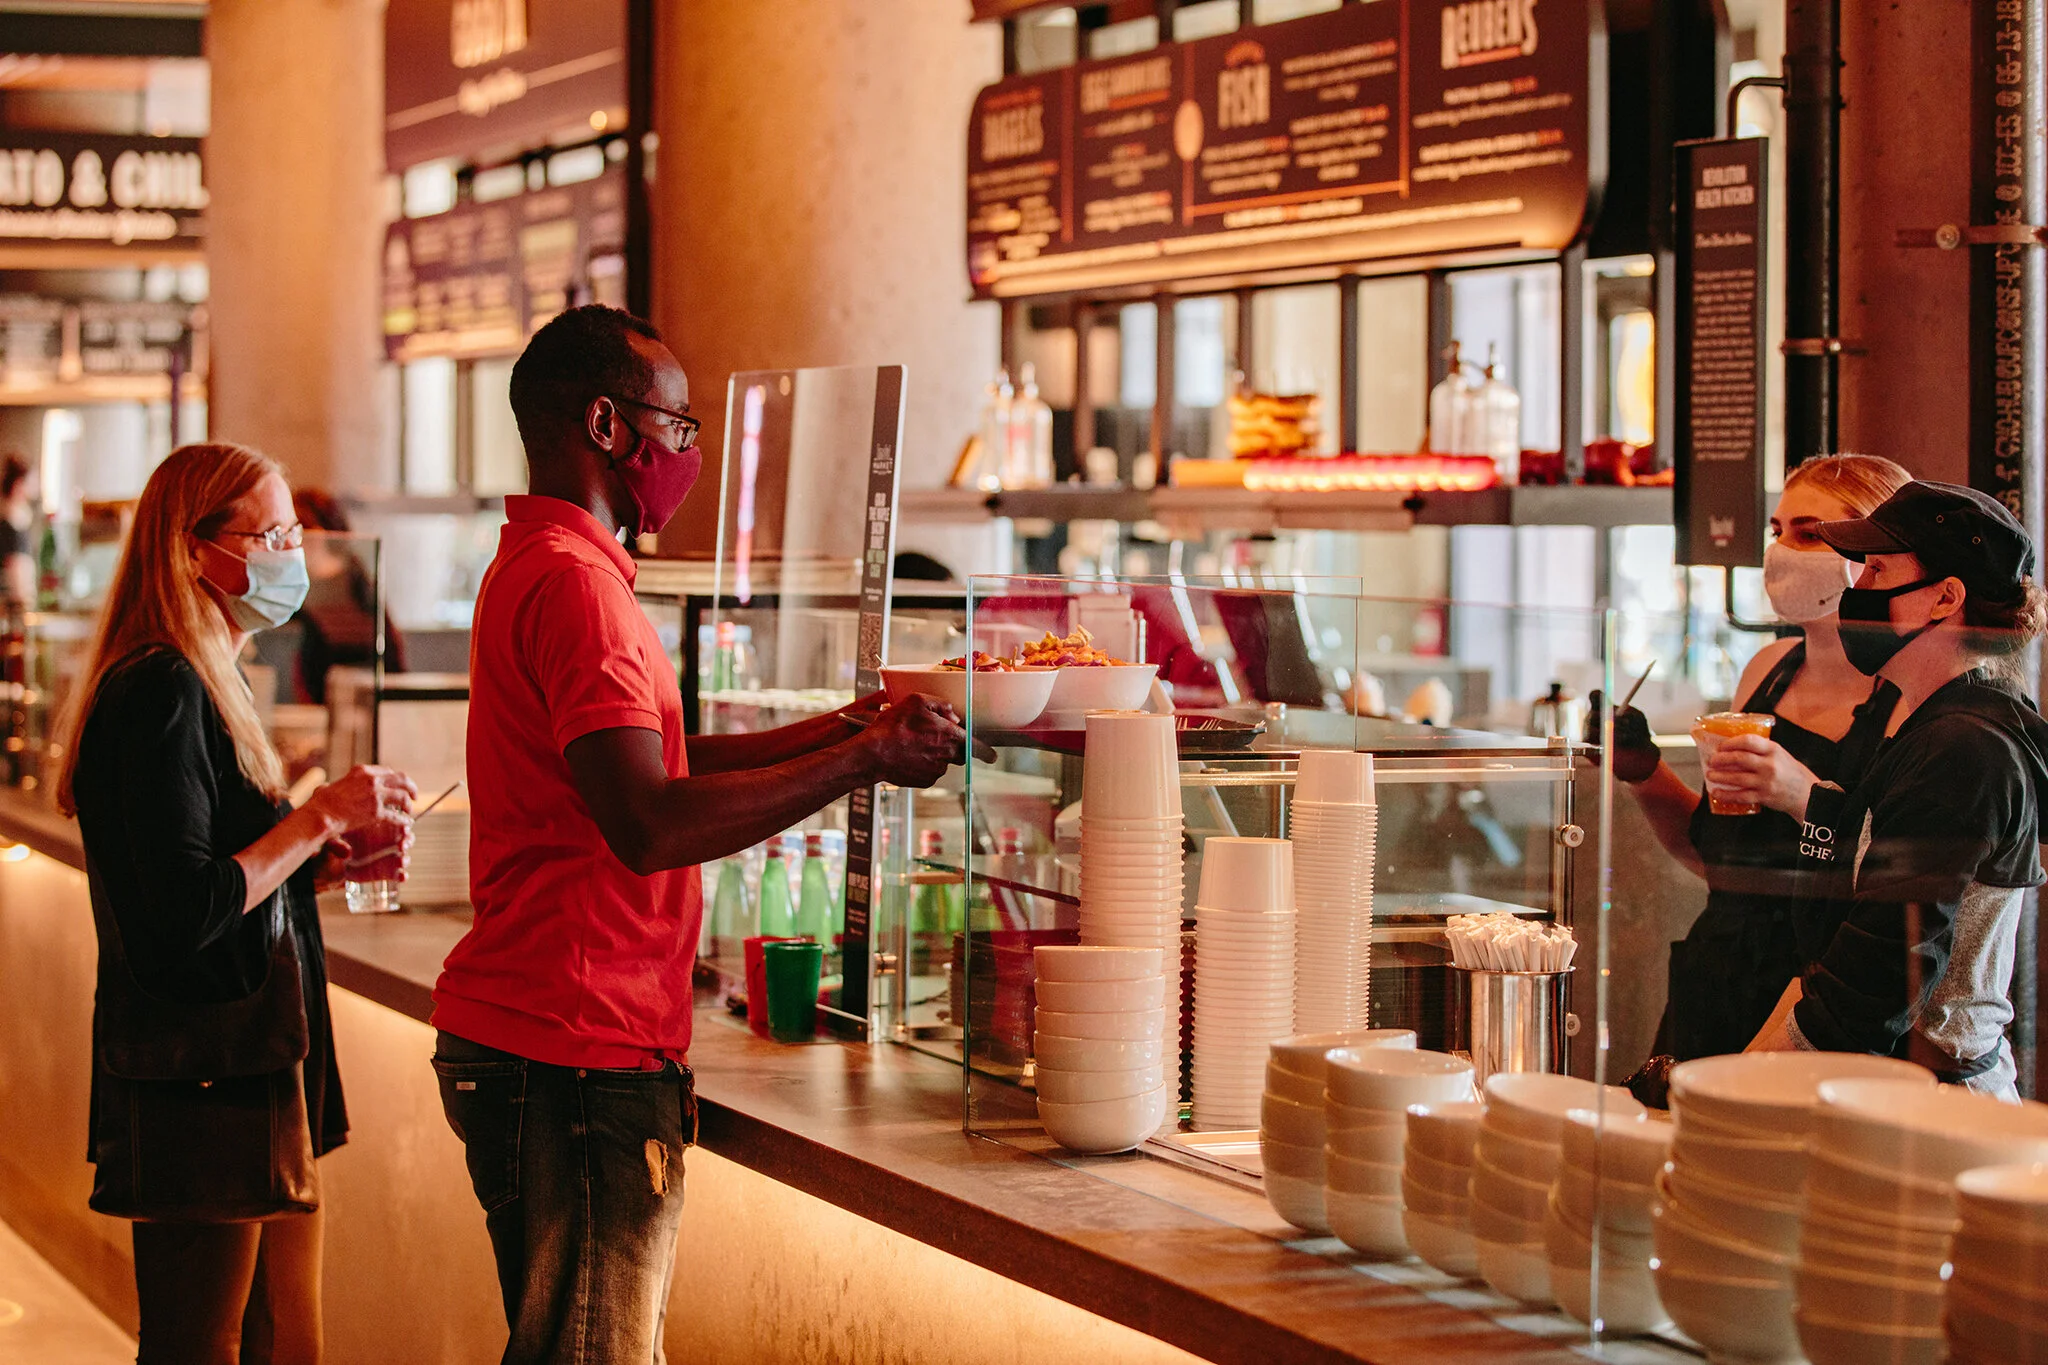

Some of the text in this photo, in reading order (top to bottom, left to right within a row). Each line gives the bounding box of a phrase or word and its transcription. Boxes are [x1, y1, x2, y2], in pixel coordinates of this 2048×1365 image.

[1217, 64, 1271, 130] FISH
[68, 149, 108, 208] &
[1799, 841, 1835, 861] CHE
[1802, 820, 1836, 845] TIO
